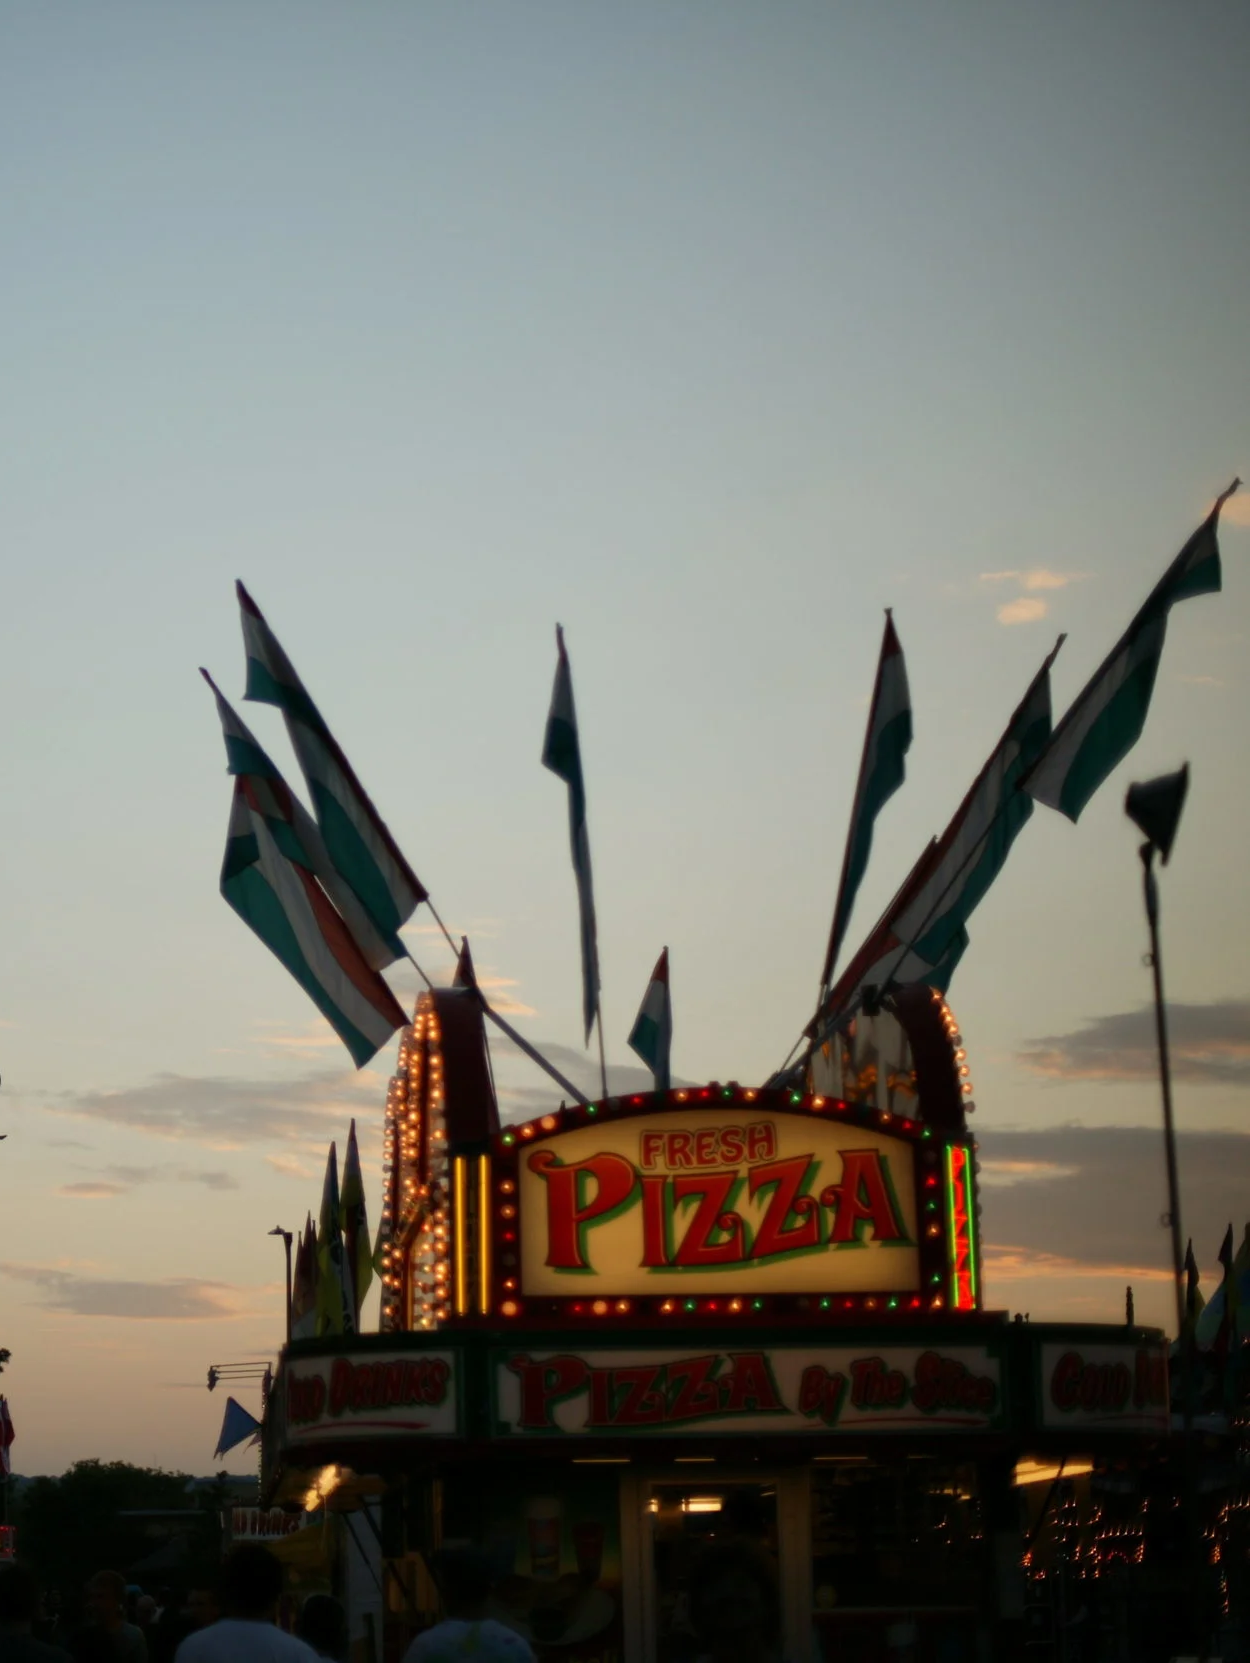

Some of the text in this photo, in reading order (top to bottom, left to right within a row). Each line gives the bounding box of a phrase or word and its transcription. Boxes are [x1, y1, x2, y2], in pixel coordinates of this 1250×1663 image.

[641, 1122, 777, 1169] FRESH
[527, 1148, 915, 1274] PIZZA
[953, 1145, 974, 1312] PIZZA
[329, 1357, 450, 1417] DRINKS
[509, 1351, 997, 1428] PIZZA By The Slice
